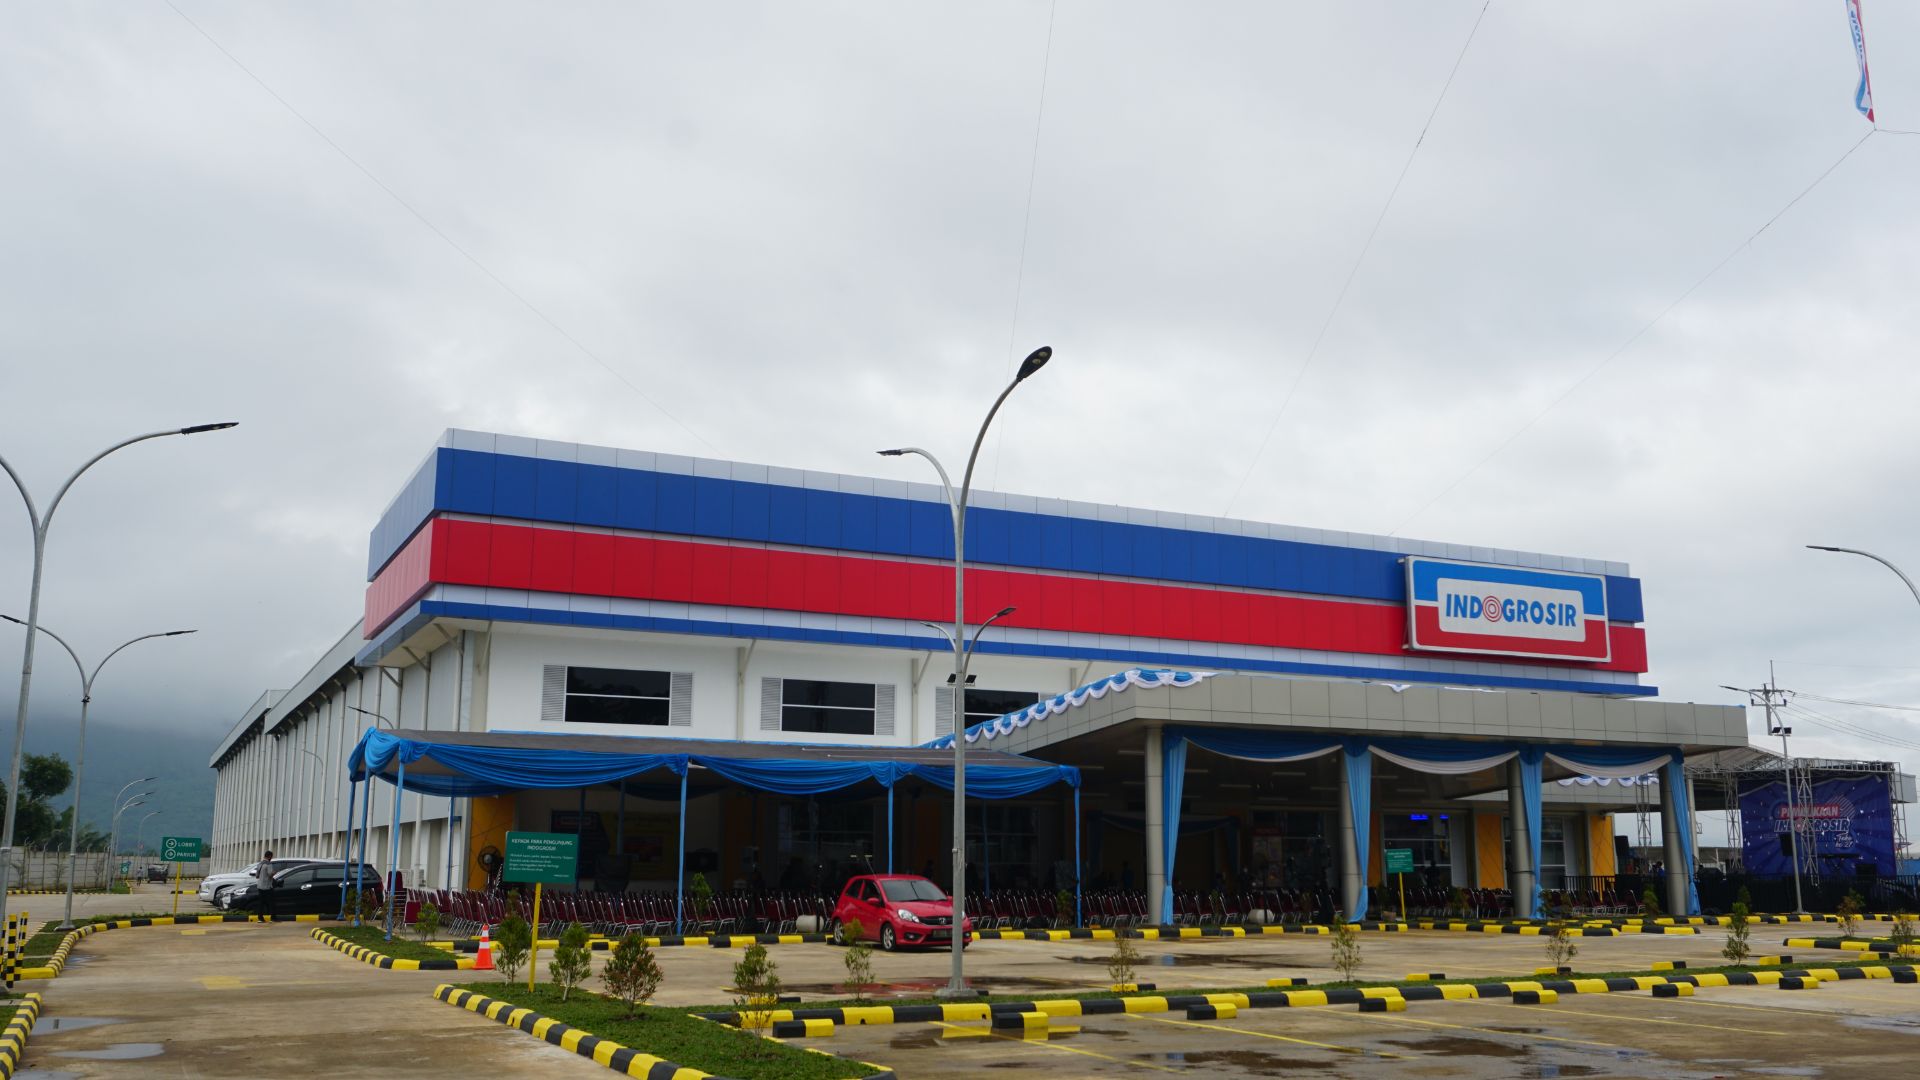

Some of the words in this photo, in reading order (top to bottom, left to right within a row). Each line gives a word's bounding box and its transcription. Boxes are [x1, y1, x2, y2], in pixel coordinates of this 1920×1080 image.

[1446, 593, 1577, 627] INDOGROSIR
[1781, 806, 1839, 817] PMUKAAN
[1774, 818, 1850, 832] INOROSIR
